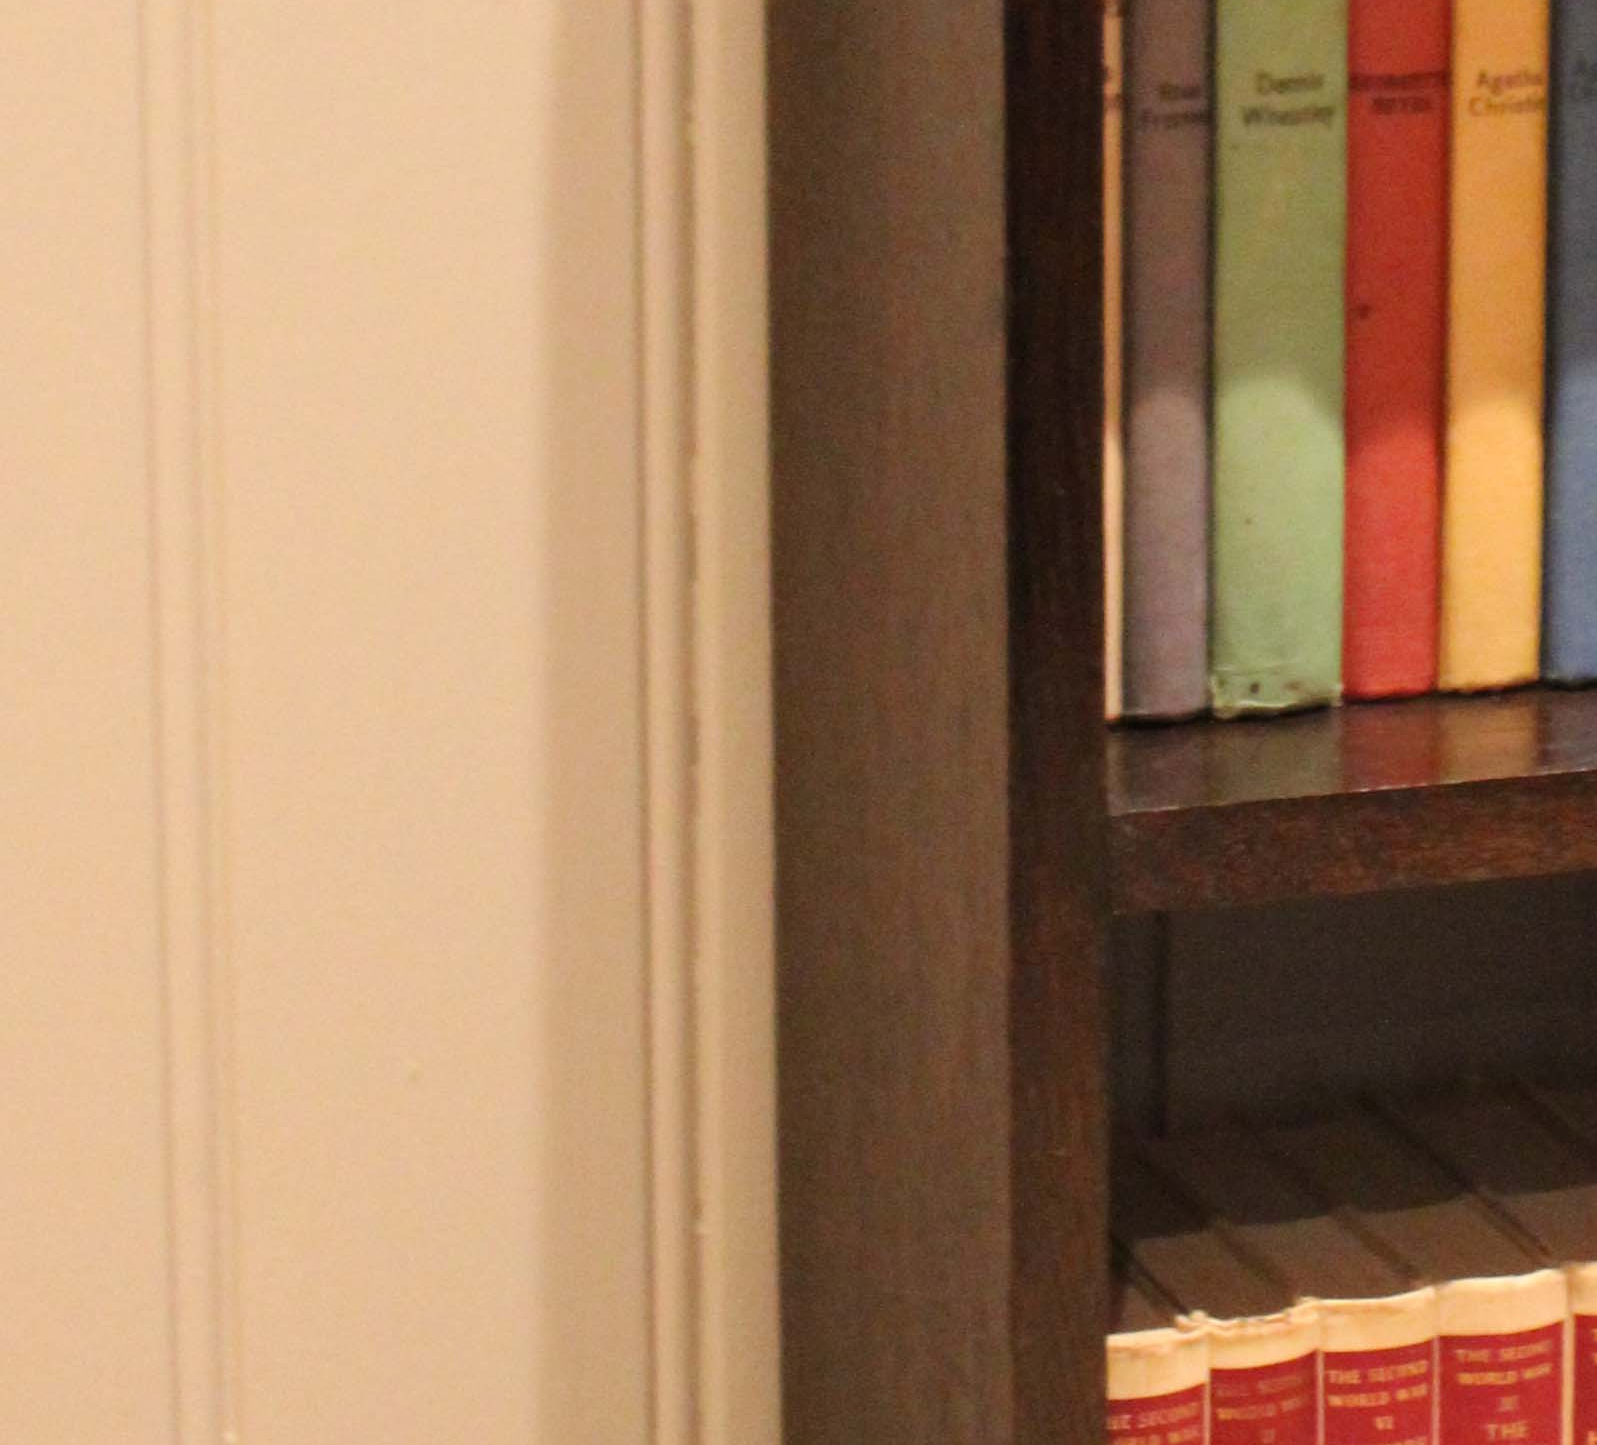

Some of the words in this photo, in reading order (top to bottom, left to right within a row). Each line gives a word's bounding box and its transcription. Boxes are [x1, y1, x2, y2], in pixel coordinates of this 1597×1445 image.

[1455, 1348, 1493, 1364] THE
[1326, 1369, 1362, 1385] THE
[1371, 1358, 1430, 1384] SECOND
[1457, 1370, 1518, 1387] WORLD
[1327, 1391, 1391, 1408] WORLD
[1483, 1421, 1531, 1443] THE
